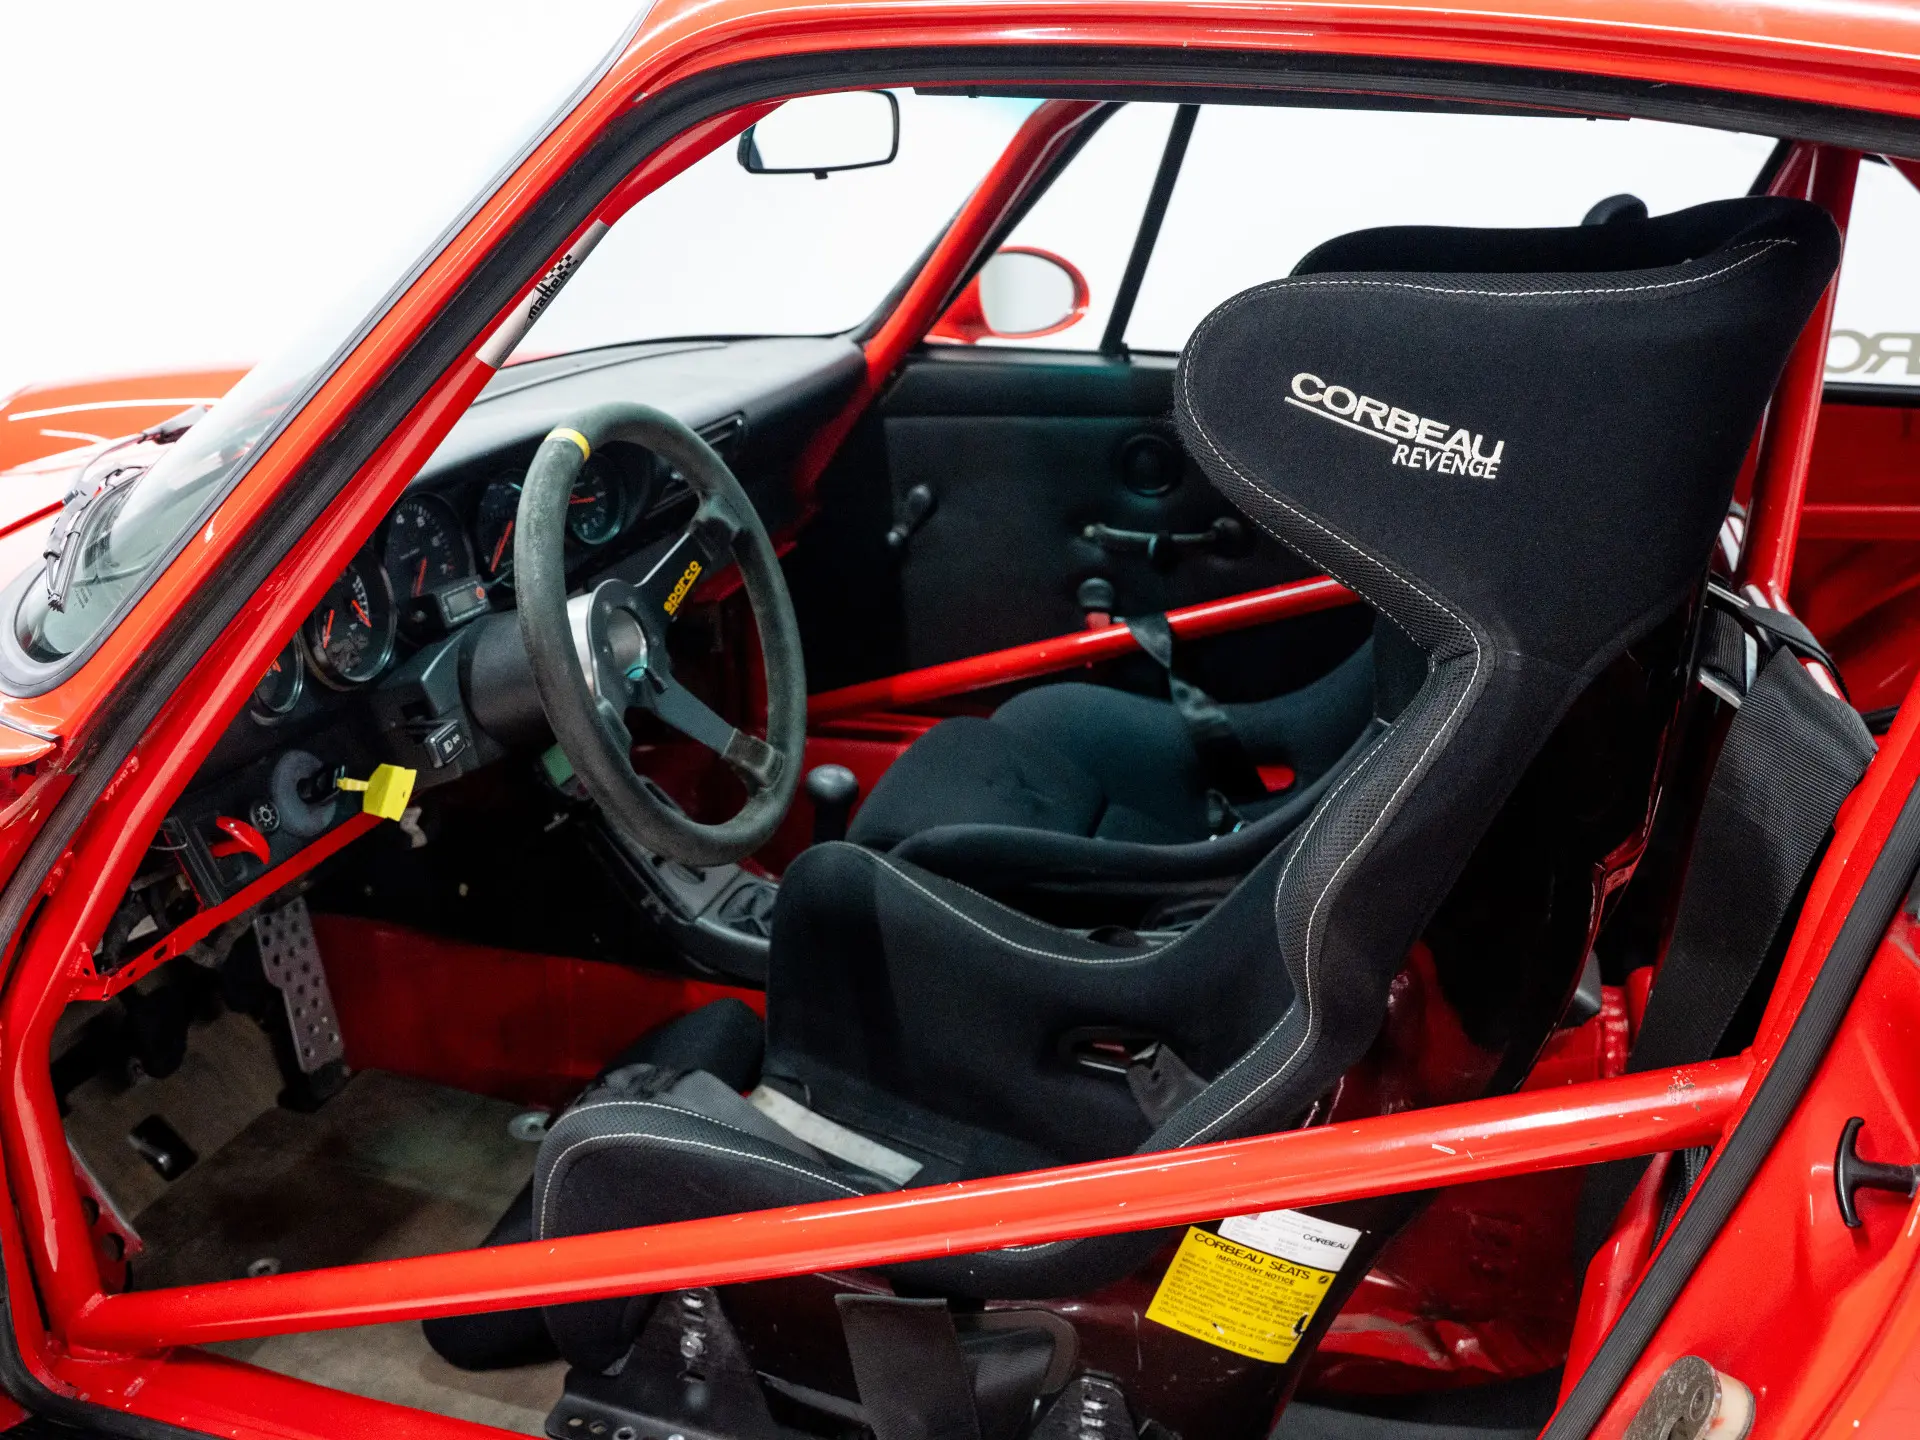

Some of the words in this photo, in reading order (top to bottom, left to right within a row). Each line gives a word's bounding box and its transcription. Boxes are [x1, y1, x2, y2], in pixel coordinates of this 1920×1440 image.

[1291, 372, 1504, 464] CORBEAU
[1392, 444, 1501, 479] REVENGE
[664, 561, 702, 615] sparco
[1194, 1232, 1264, 1265] CORBEAU
[1269, 1261, 1310, 1280] SEATS
[1302, 1234, 1350, 1250] CORBEAU
[1216, 1253, 1264, 1277] IMPORTANT
[1264, 1271, 1296, 1286] NOTICE
